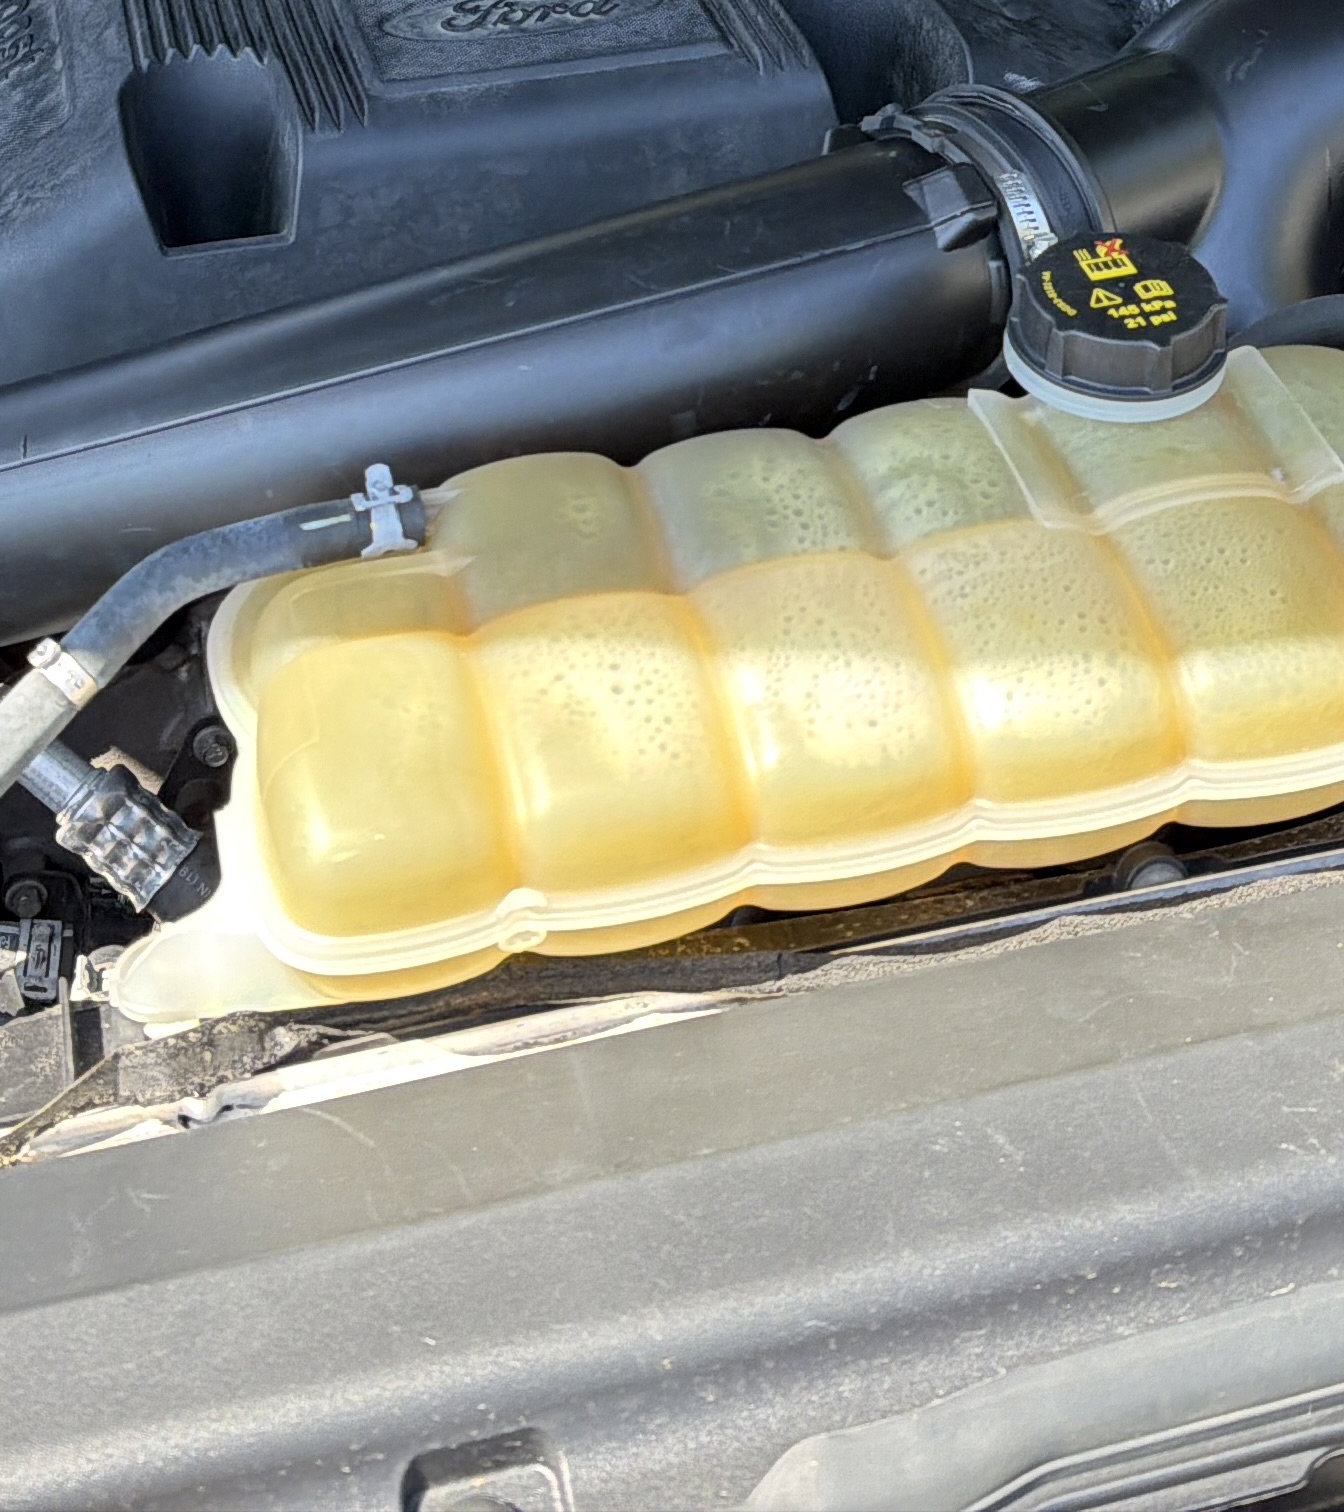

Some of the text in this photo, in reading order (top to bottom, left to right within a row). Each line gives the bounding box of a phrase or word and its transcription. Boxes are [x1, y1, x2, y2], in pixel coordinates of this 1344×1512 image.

[1107, 299, 1177, 319] 145 kPa
[1123, 310, 1178, 329] 21 psi
